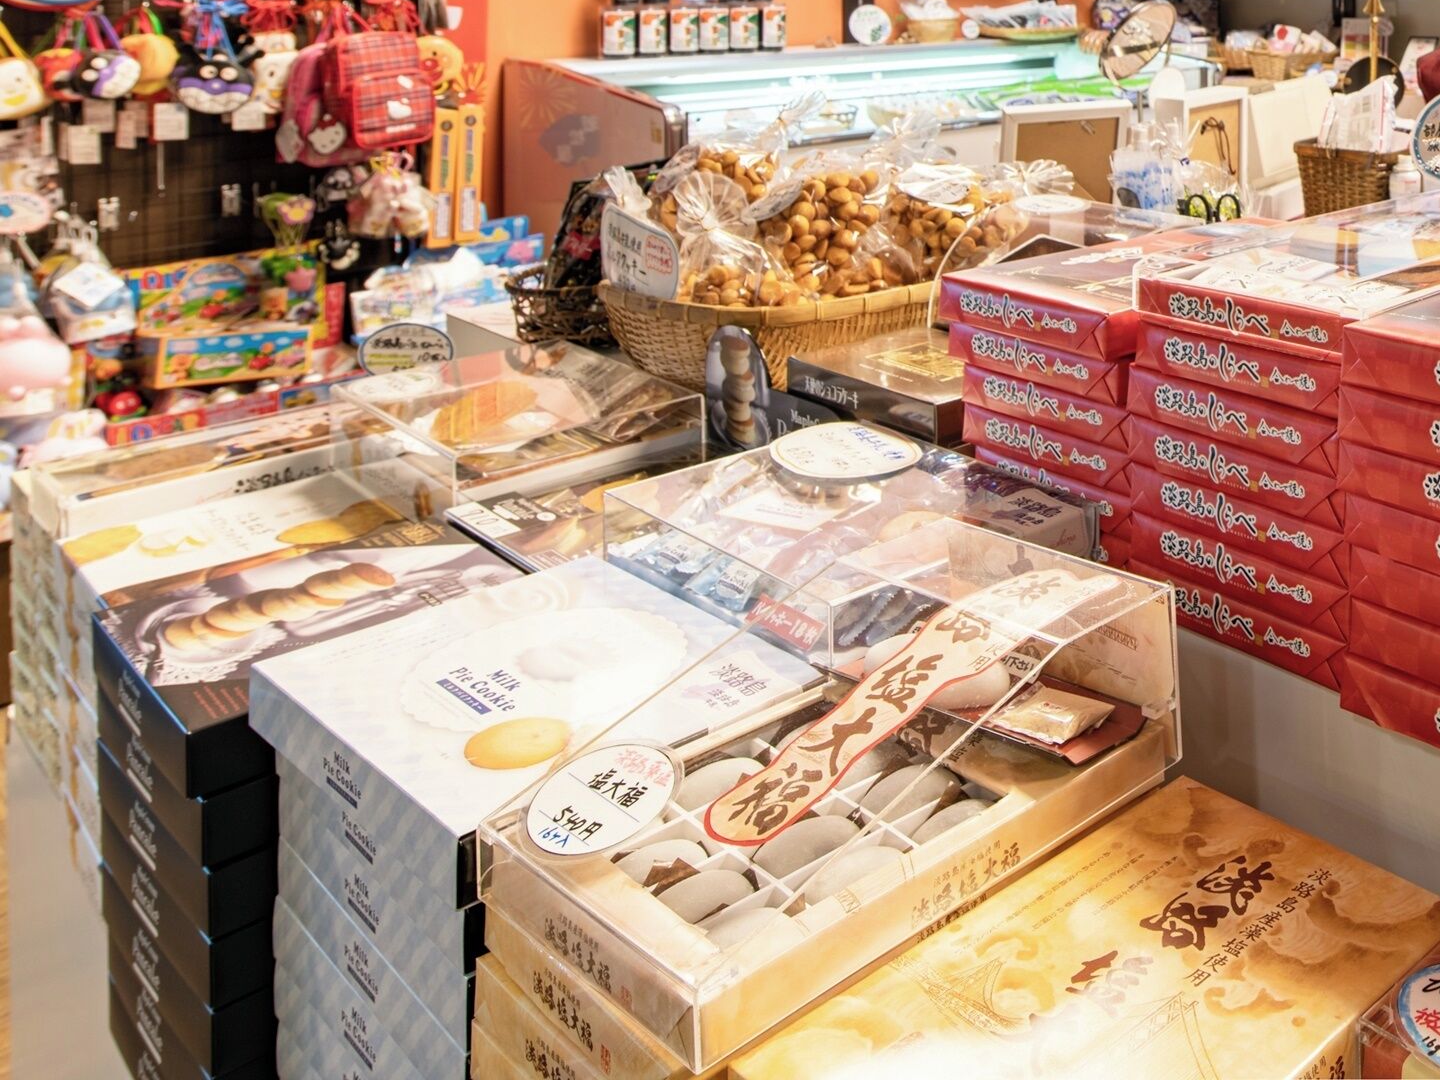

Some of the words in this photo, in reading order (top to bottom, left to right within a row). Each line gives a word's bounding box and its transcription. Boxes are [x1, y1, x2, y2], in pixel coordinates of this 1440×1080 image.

[1170, 293, 1270, 334] 淡路島のしらべ
[1165, 338, 1260, 381] 淡路島のしらべ
[1156, 385, 1248, 431] 淡路島のしらべ
[1156, 435, 1249, 485] 淡路島のしらべ
[1162, 482, 1256, 534] 淡路島のしらべ
[1161, 531, 1255, 586] 淡路島のしらべ
[1172, 587, 1254, 638] 路島のしらべ
[449, 666, 471, 683] Pie
[469, 678, 519, 713] Cookie
[486, 669, 523, 692] Milk
[710, 662, 768, 698] 淡路島
[323, 757, 335, 777] Pie
[336, 768, 362, 800] Cookie
[334, 752, 350, 774] Milk
[588, 768, 649, 809] 塩大福
[342, 811, 352, 826] Pie
[353, 822, 377, 857] Cookie
[552, 805, 604, 842] 540円
[344, 878, 355, 899] Pie
[356, 889, 380, 926] Cookie
[354, 874, 369, 899] Milk
[1184, 866, 1332, 988] 淡路島産藻塩使用
[344, 945, 355, 965] Pie
[355, 955, 379, 996] Cookie
[354, 941, 368, 967] Milk
[341, 1010, 352, 1031] Pie
[352, 1022, 376, 1063] Cookie
[352, 1007, 367, 1034] Milk
